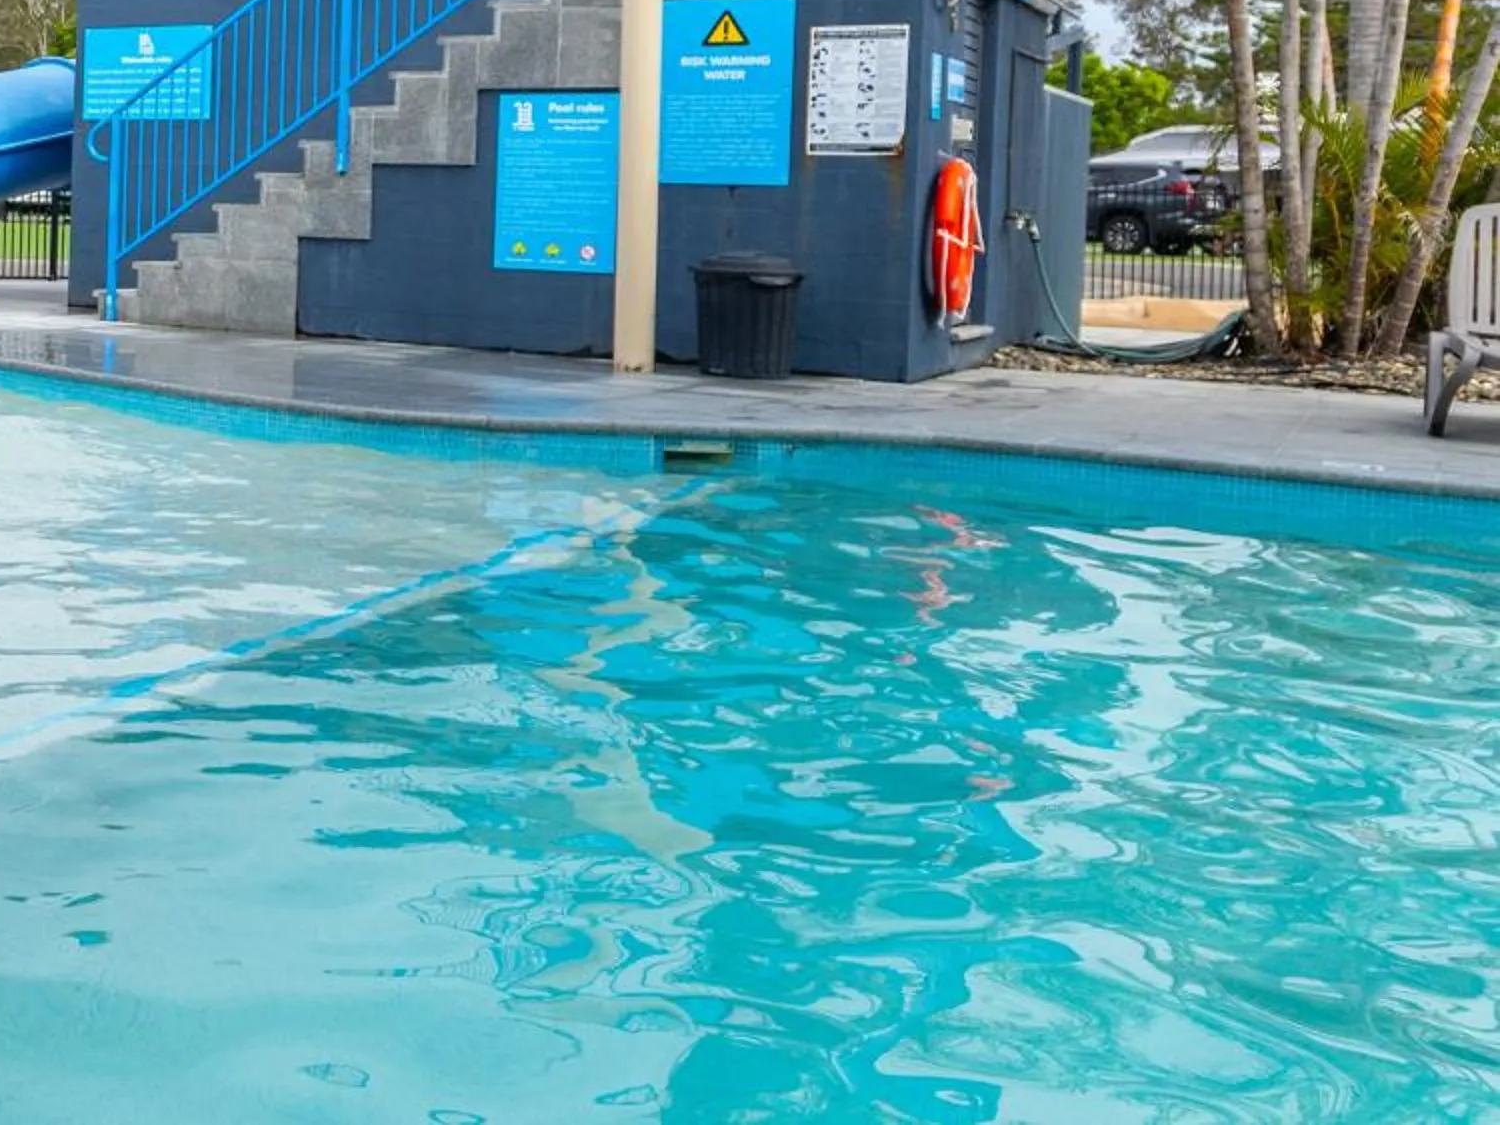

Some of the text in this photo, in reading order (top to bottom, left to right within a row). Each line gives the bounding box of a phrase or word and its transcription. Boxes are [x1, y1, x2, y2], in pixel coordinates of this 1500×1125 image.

[681, 55, 771, 67] RISK WARNING
[704, 70, 746, 80] WATER
[548, 101, 605, 114] Pool rules
